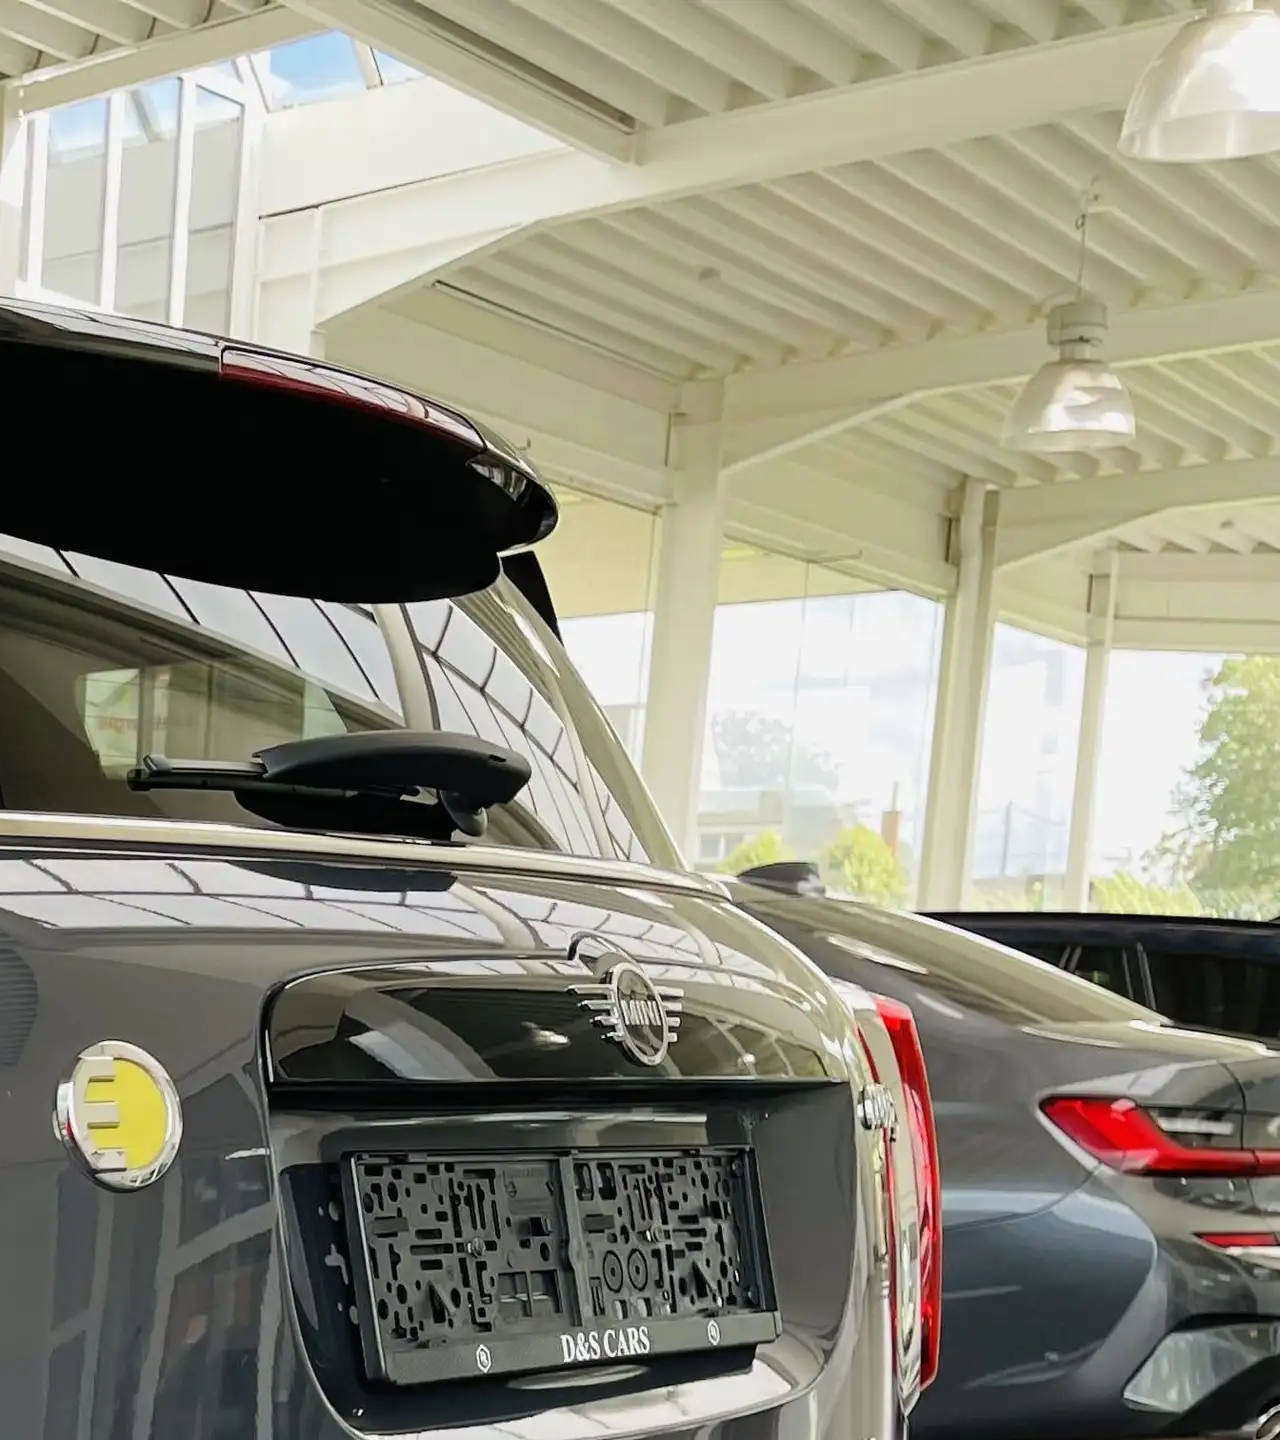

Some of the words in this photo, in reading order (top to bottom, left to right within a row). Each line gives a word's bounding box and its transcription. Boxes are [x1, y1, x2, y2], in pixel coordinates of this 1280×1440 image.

[621, 999, 662, 1026] MINI
[560, 1331, 601, 1363] D&S
[603, 1326, 650, 1358] CARS
